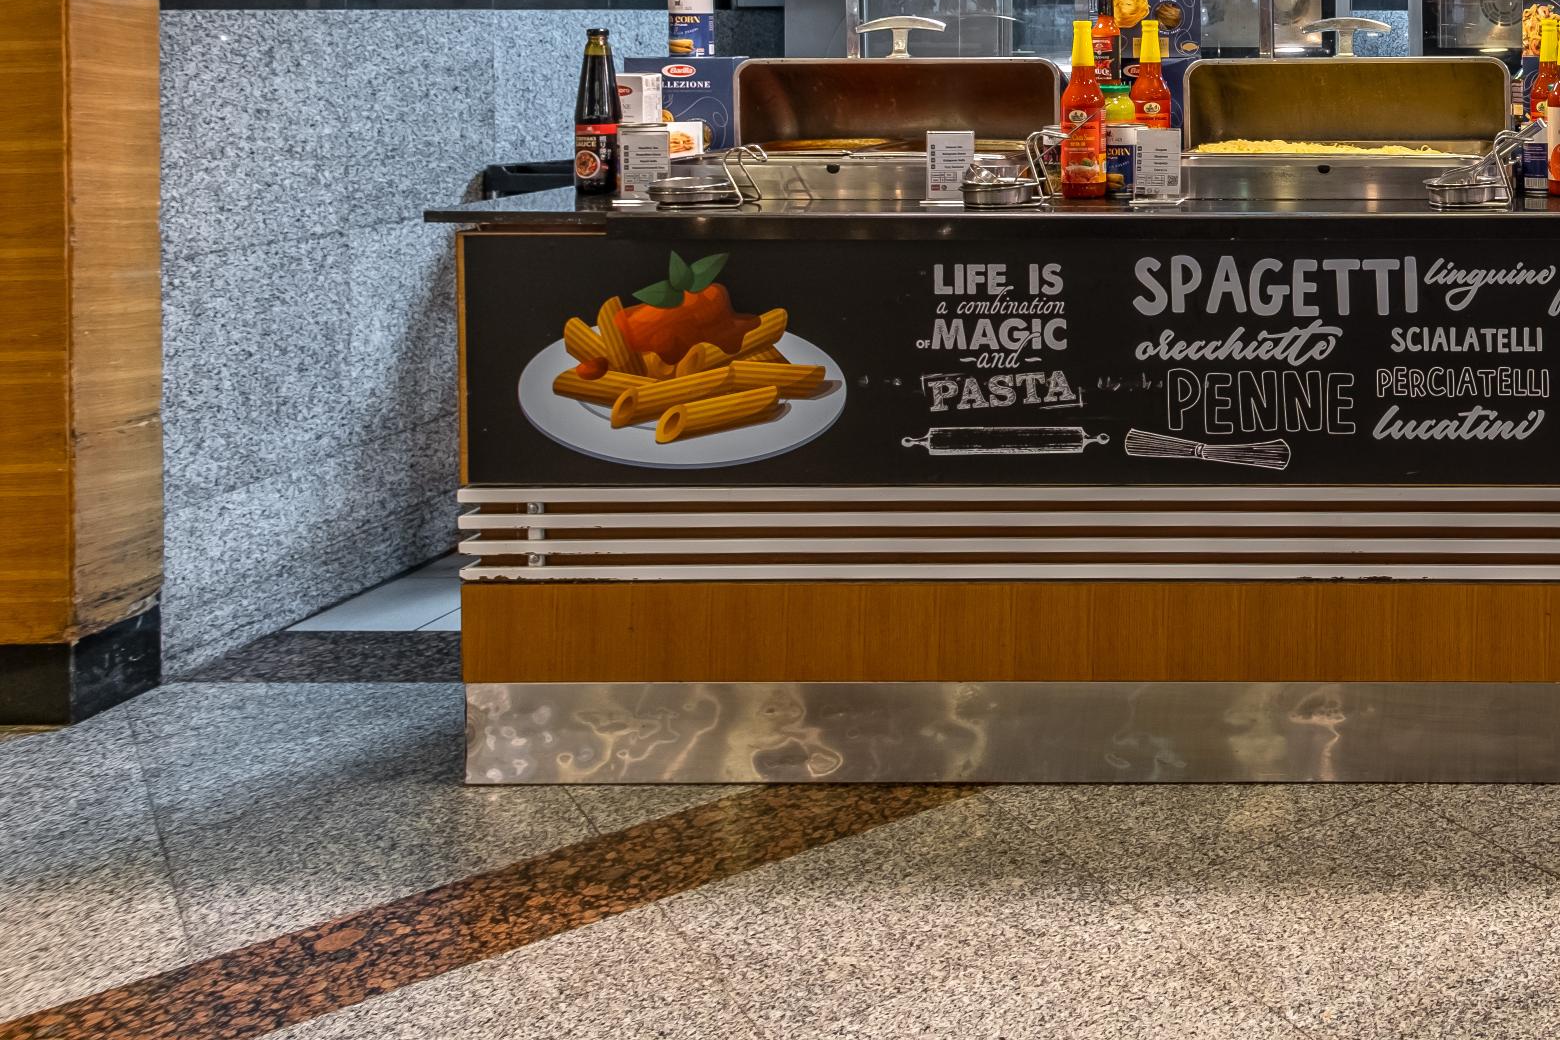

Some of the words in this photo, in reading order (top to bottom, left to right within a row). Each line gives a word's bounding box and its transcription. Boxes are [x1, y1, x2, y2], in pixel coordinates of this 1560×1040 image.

[933, 263, 1007, 296] LIFE
[1028, 263, 1064, 295] IS
[1132, 255, 1418, 317] SPAGETTI
[936, 301, 948, 315] a
[956, 285, 1066, 316] combination
[916, 339, 931, 349] OF
[931, 318, 1068, 351] MAGIC
[976, 332, 1041, 368] and
[1390, 326, 1543, 353] SCIALATELLI
[927, 370, 1077, 412] PASTA
[1167, 368, 1356, 435] PENNE
[1376, 367, 1550, 398] PERCIATELLI
